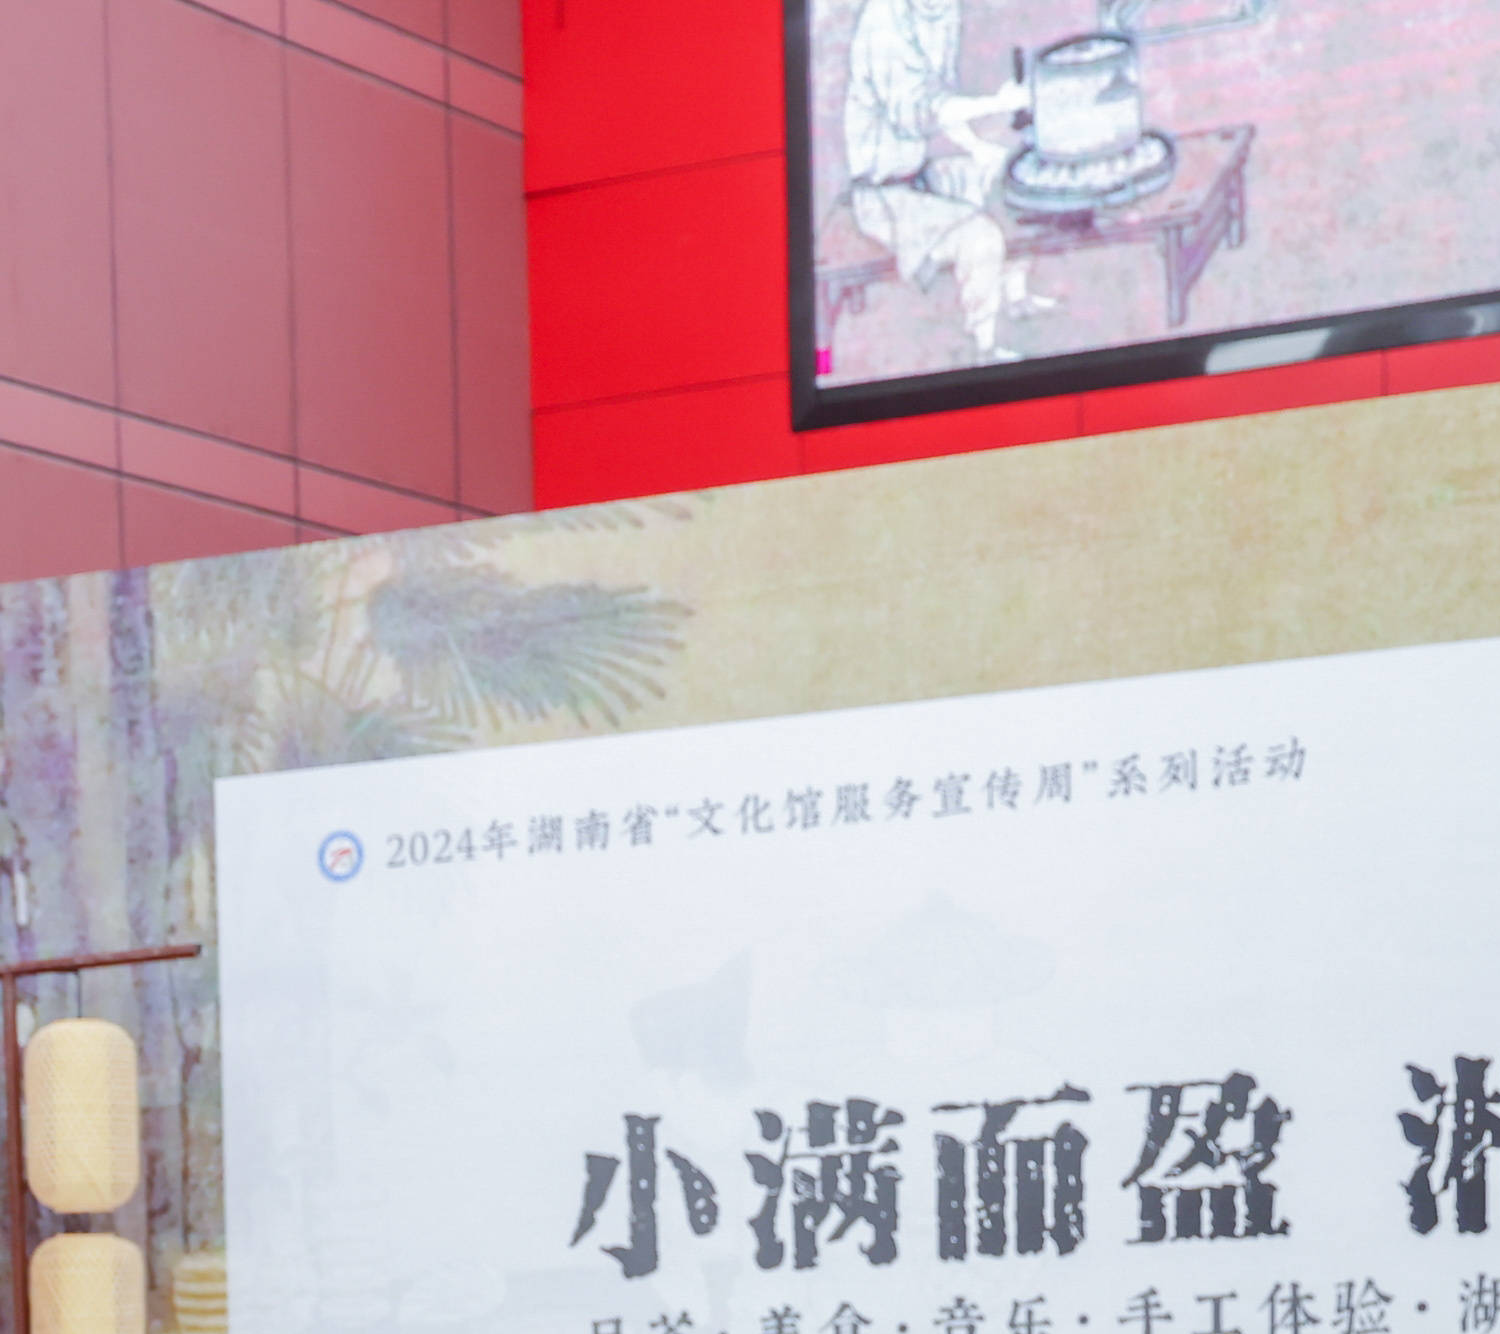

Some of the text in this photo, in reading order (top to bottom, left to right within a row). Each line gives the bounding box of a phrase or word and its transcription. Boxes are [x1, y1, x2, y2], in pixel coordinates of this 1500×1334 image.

[385, 736, 1309, 870] 2024年湖南省“文化馆服务宣传周”系列活动
[569, 1070, 1295, 1279] 小满而盈
